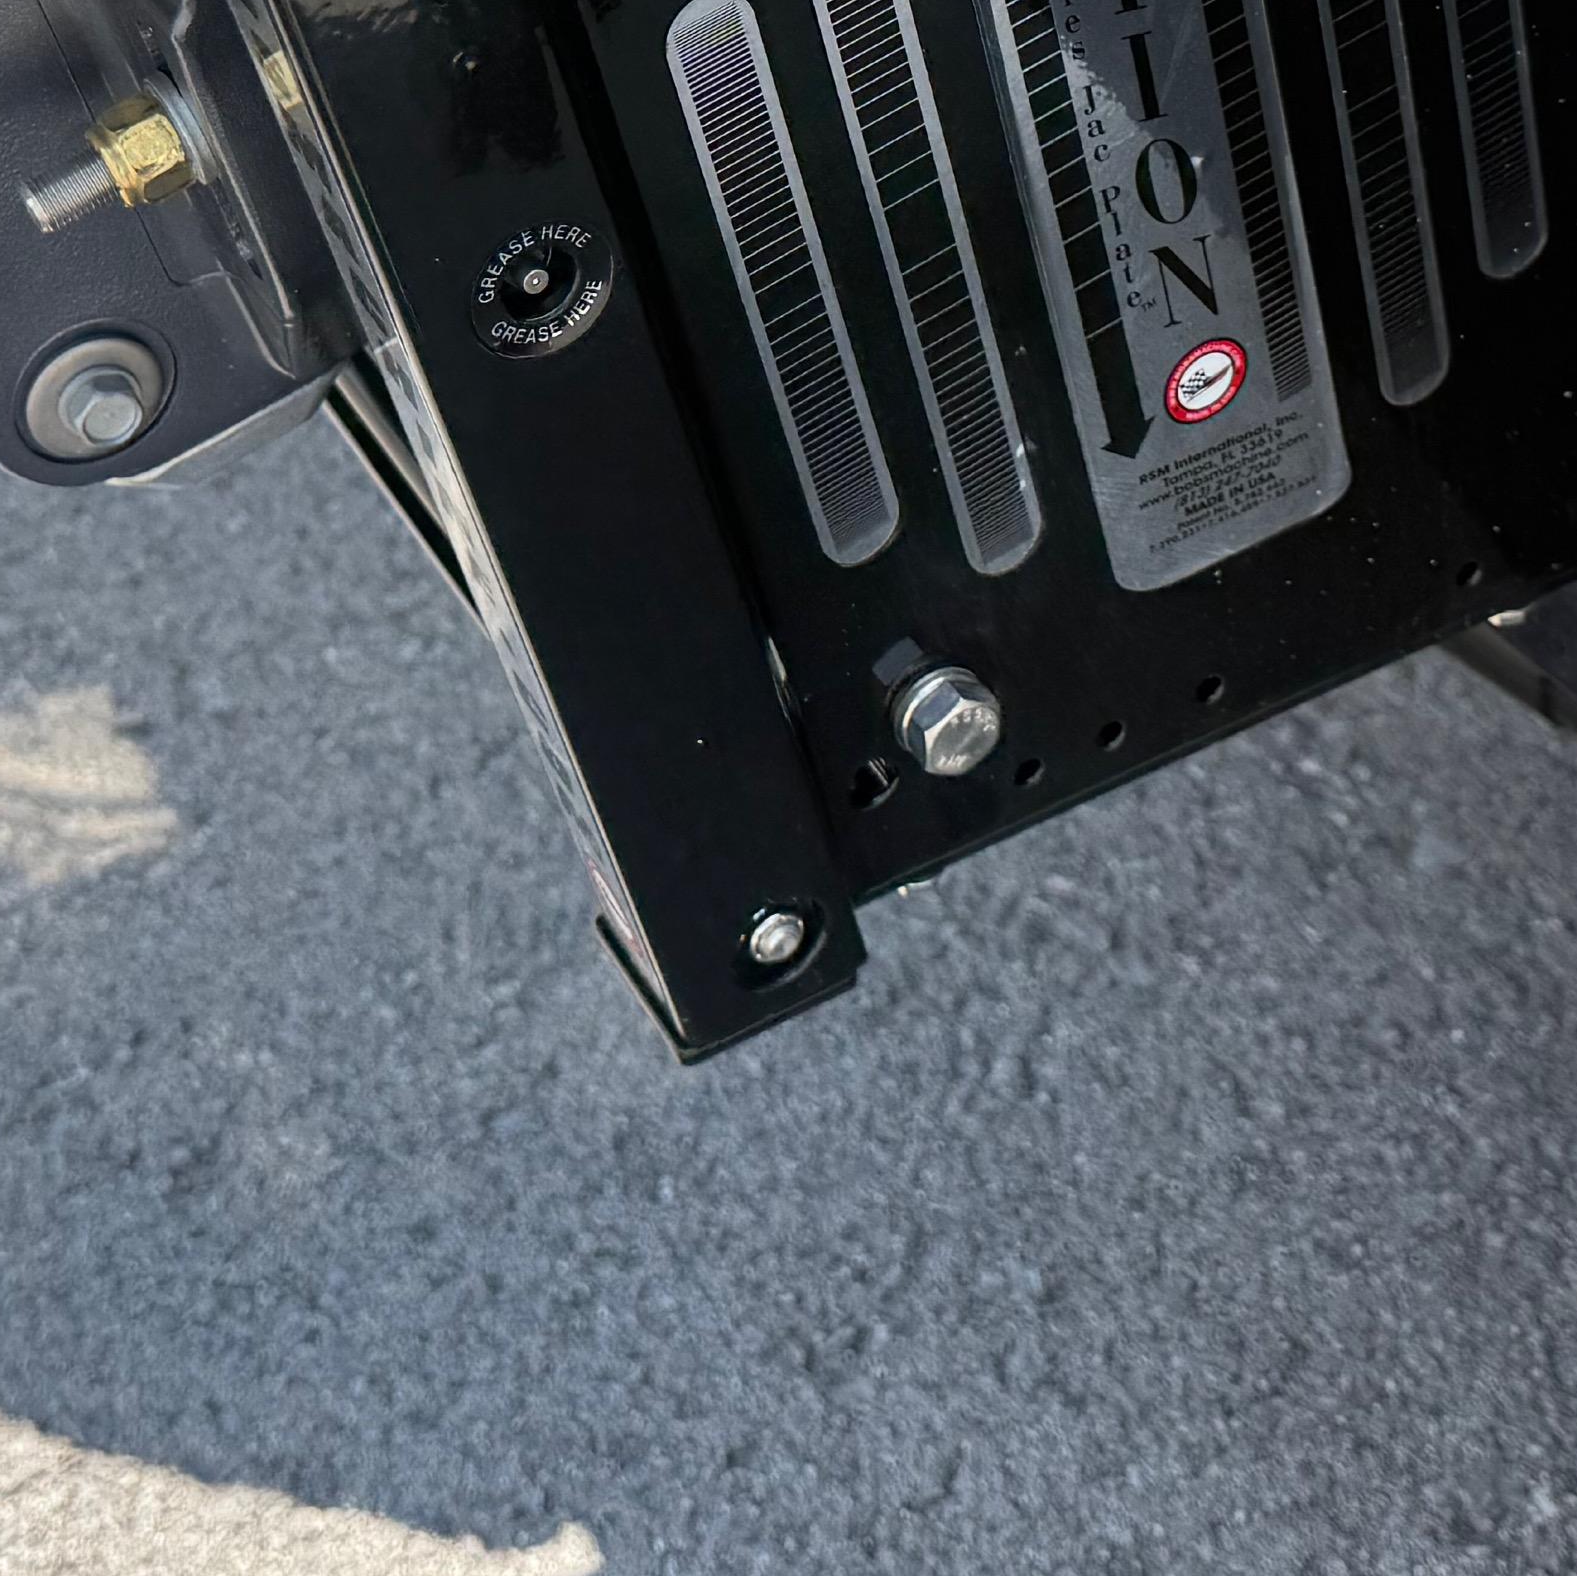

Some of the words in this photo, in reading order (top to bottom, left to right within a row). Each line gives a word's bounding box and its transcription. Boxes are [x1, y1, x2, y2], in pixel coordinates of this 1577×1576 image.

[1082, 82, 1114, 166] Jac
[478, 229, 536, 305] GREASE
[540, 224, 592, 250] HERE
[490, 320, 564, 345] GREASE
[563, 278, 603, 328] HERE
[1138, 464, 1171, 487] RSM
[1275, 410, 1304, 428] Inc.
[1184, 491, 1225, 517] MADE
[1228, 482, 1245, 498] IN
[1246, 471, 1278, 491] USA
